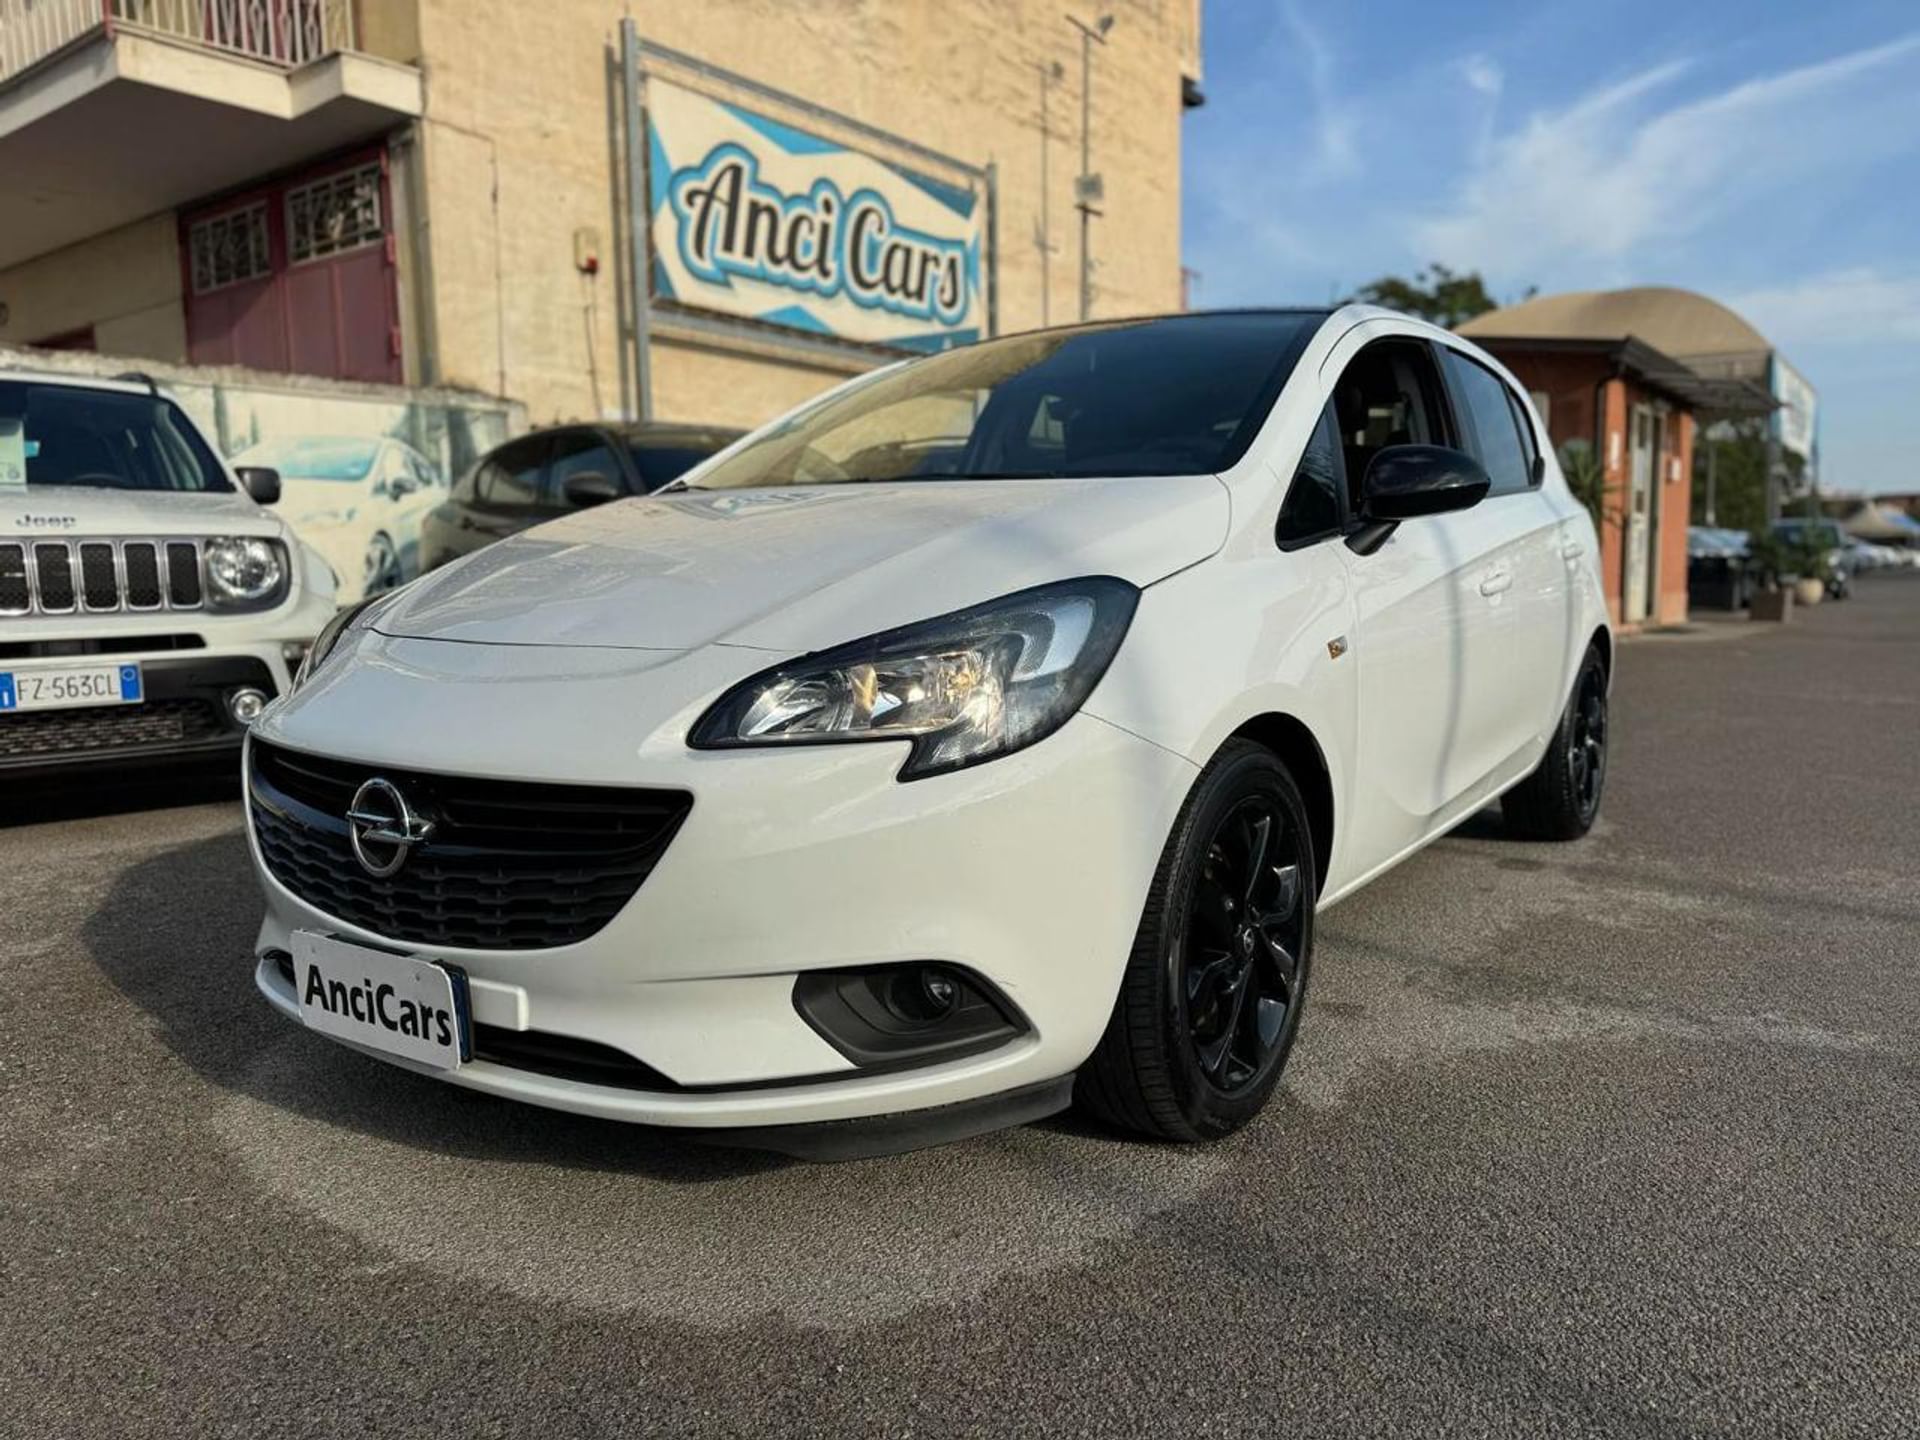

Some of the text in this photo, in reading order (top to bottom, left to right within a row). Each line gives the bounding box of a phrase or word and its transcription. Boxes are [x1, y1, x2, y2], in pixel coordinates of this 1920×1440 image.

[685, 163, 960, 309] Anci Cars
[305, 964, 452, 1046] AnciCars
